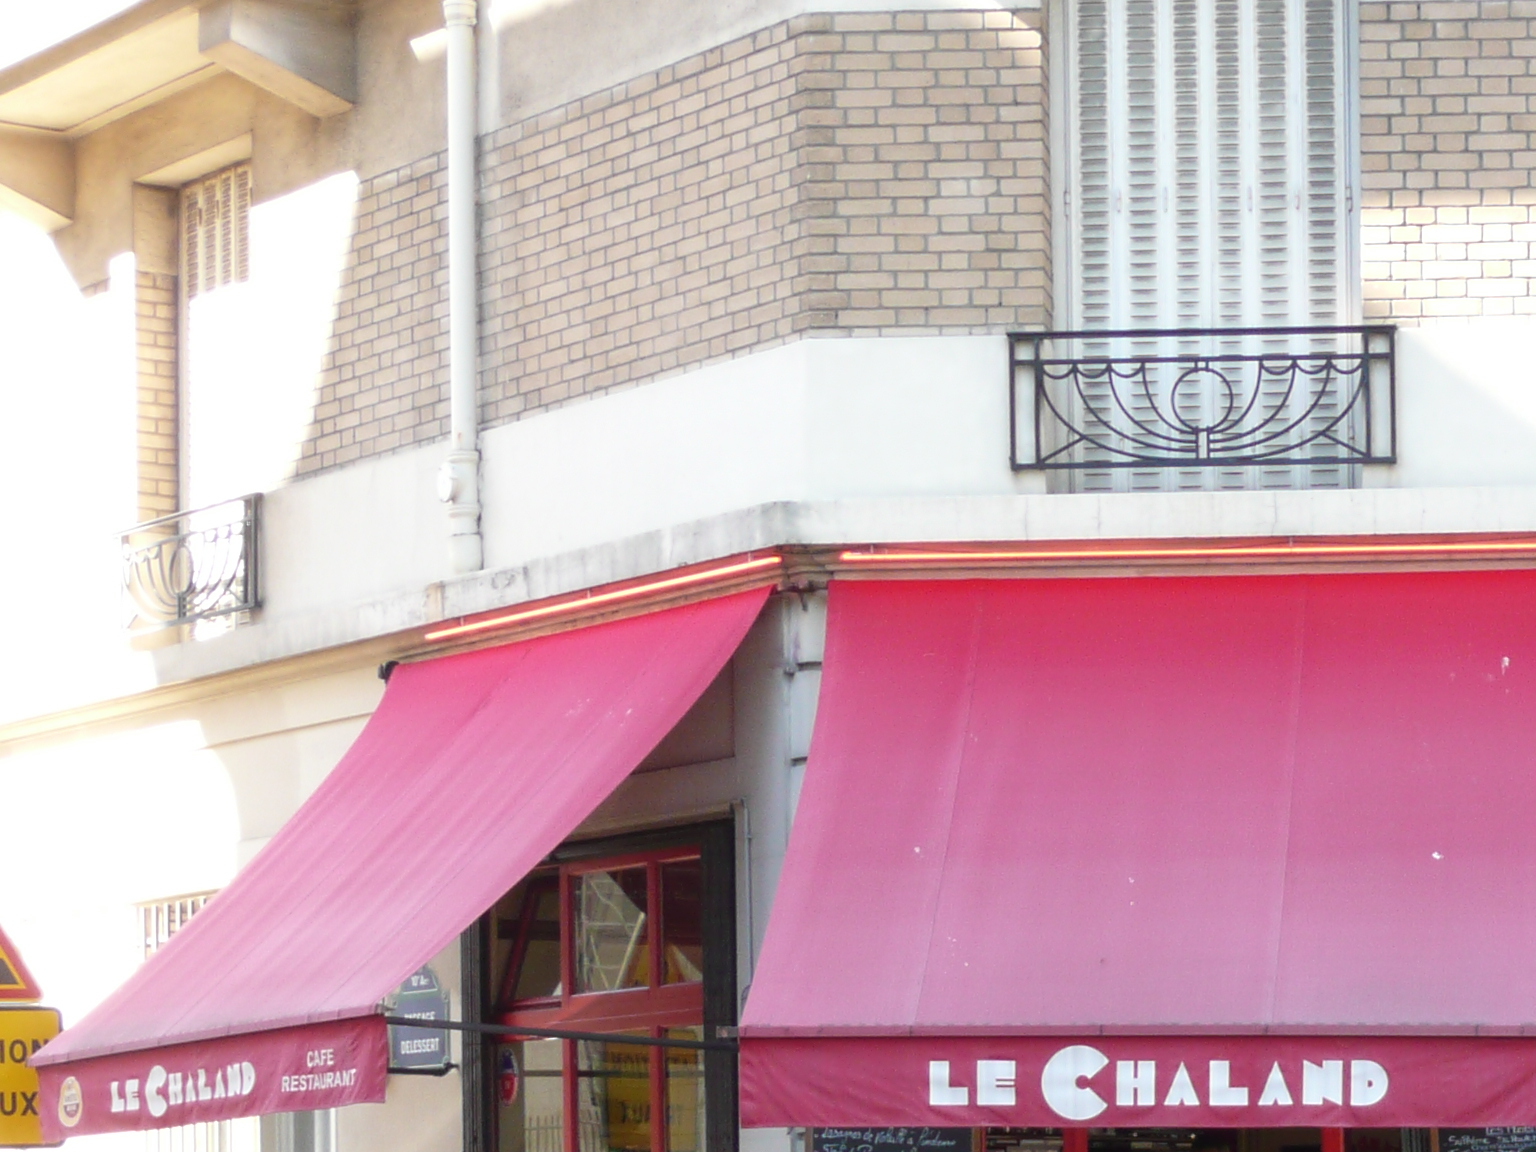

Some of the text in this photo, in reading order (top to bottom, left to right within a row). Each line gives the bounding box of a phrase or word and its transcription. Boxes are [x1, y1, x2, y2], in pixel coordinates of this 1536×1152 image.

[306, 1048, 335, 1068] CAFE
[400, 1037, 440, 1055] DELESSERT
[111, 1078, 140, 1112] LE
[145, 1064, 256, 1117] CHALAND
[281, 1067, 357, 1093] RESTAURANT
[928, 1044, 1389, 1121] LE CHALAND
